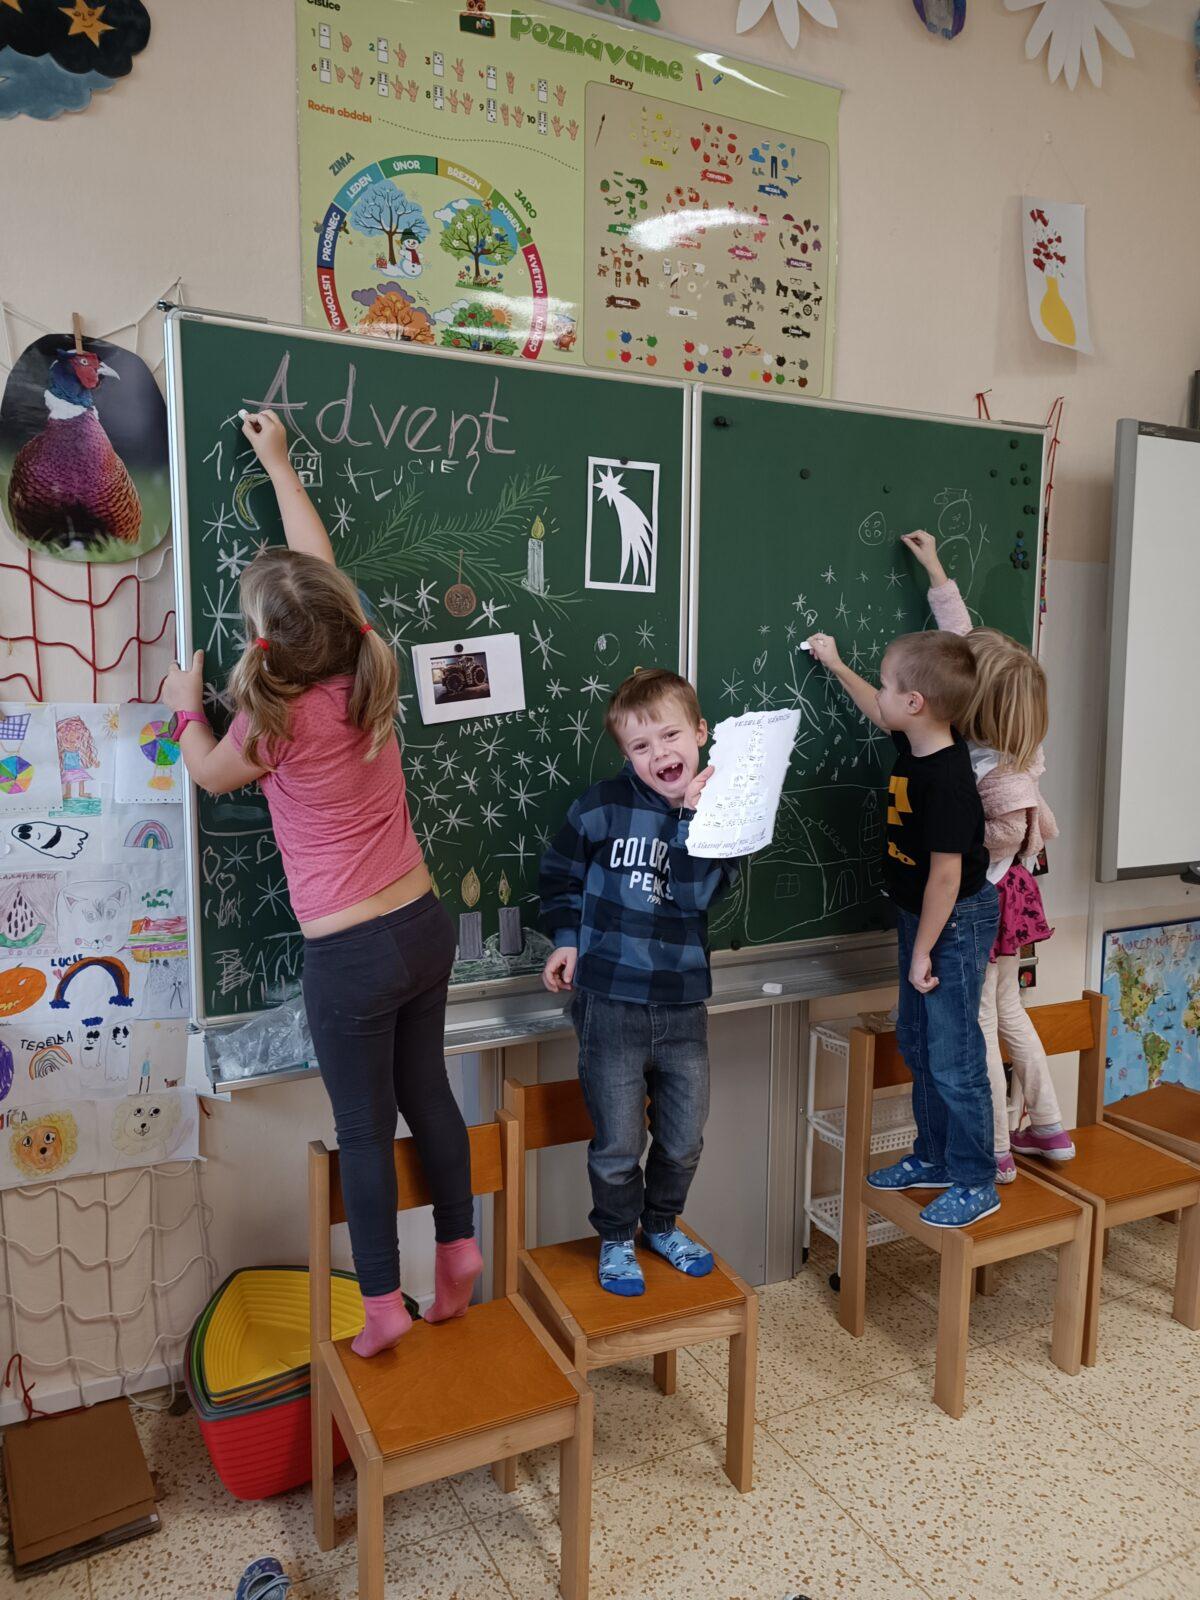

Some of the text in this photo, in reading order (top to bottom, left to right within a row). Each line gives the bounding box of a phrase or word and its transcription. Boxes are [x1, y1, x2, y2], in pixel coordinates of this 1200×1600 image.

[510, 9, 684, 82] Poznáváme
[609, 74, 635, 90] Barvy
[328, 152, 356, 177] ZIMA
[346, 173, 374, 199] LEDEN
[514, 188, 537, 219] JARO
[497, 201, 522, 233] DUBEN
[322, 211, 341, 262] PROSINEC
[321, 275, 341, 327] LISTOPAD
[242, 351, 516, 458] Advent
[370, 458, 460, 501] LUCIE
